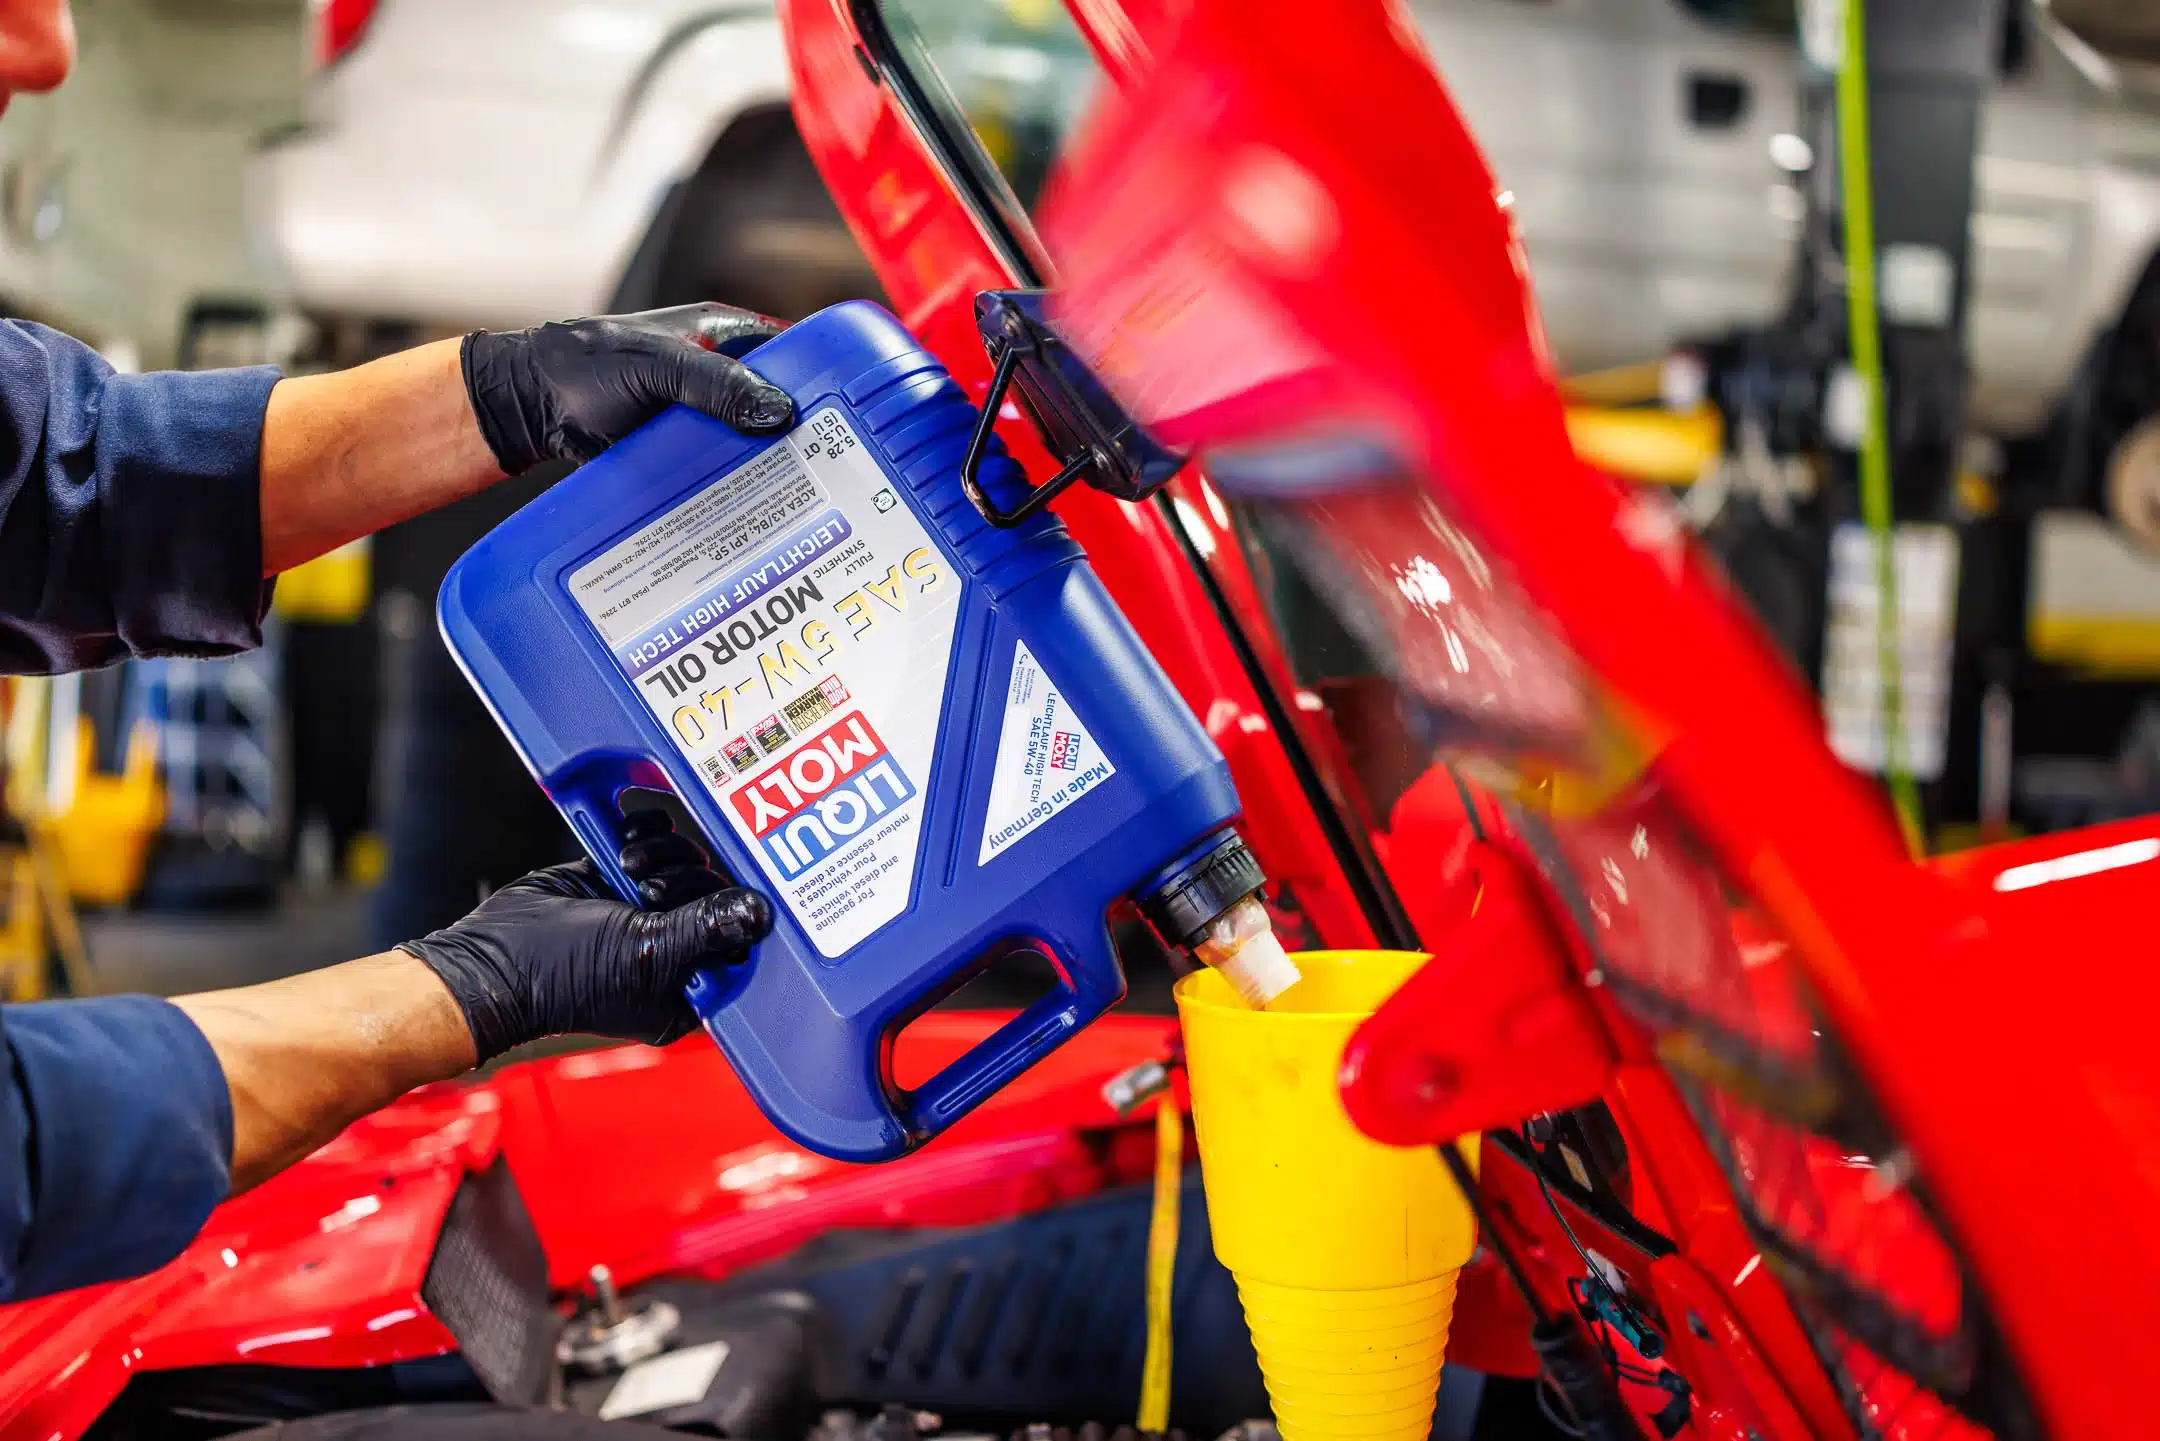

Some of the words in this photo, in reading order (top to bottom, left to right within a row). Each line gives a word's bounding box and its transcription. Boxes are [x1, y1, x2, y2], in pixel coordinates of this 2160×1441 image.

[823, 411, 839, 428] (5
[819, 424, 847, 445] U.S.
[771, 446, 788, 459] Opel
[803, 442, 821, 461] QT
[826, 435, 856, 460] 5.28
[766, 452, 792, 473] Chrysler
[704, 483, 731, 503] Peugeot
[782, 473, 807, 492] Porsche
[795, 479, 812, 494] BMW
[757, 491, 795, 517] Longlife-01;
[767, 488, 783, 501] A40;
[785, 486, 817, 511] ACEA
[681, 500, 706, 517] Citroen
[699, 504, 713, 516] Fiat
[735, 513, 747, 524] RN
[745, 498, 770, 517] Renault
[651, 525, 665, 538] B71
[663, 514, 683, 530] (PSA)
[702, 519, 737, 543] 0700/0710;
[718, 515, 758, 544] MB-Approval
[748, 506, 786, 535] A3/B4;
[693, 541, 705, 552] VW
[728, 531, 749, 551] API
[660, 555, 683, 572] 00/505
[673, 553, 700, 573] Peugeot
[680, 547, 694, 559] 502
[708, 545, 730, 561] SP;
[727, 516, 845, 604] LEICHTLAUF
[813, 539, 866, 579] SYNTHETIC
[844, 551, 874, 577] FULLY
[603, 562, 623, 576] GWM;
[649, 570, 673, 588] Citroen
[580, 574, 605, 591] HAVAL;
[631, 585, 650, 601] (PSA)
[831, 544, 946, 642] SAE
[599, 606, 618, 620] 2296;
[618, 597, 632, 609] B71
[679, 592, 731, 635] HIGH
[701, 574, 824, 666] MOTOR
[627, 623, 683, 669] TECH
[644, 653, 707, 699] OIL
[670, 613, 846, 752] 5W-40
[785, 689, 825, 720] MARKEN
[815, 697, 833, 717] DIE
[790, 705, 822, 733] BESTEN
[1029, 716, 1043, 739] SAE
[1039, 692, 1057, 751] LEICHTLAUF
[1023, 740, 1039, 775] 5W-40
[1050, 731, 1068, 768] MOLY
[1062, 733, 1080, 770] LIQUI
[711, 768, 725, 780] TOP
[1034, 752, 1046, 776] HIGH
[744, 717, 879, 834] MOLY
[1067, 761, 1109, 793] Made
[1030, 778, 1042, 803] TECH
[1051, 789, 1070, 804] in
[764, 754, 911, 875] LIQUI
[988, 801, 1054, 850] Germany
[876, 813, 910, 842] moteur
[836, 838, 875, 868] essence
[853, 851, 877, 872] Pour
[880, 855, 899, 873] and
[824, 865, 836, 877] et
[850, 868, 880, 894] diesel
[792, 873, 825, 898] diesel.
[806, 869, 853, 903] véhicules
[857, 887, 875, 904] For
[799, 900, 808, 910] à
[808, 889, 851, 920] vehicles.
[815, 898, 856, 931] gasoline
